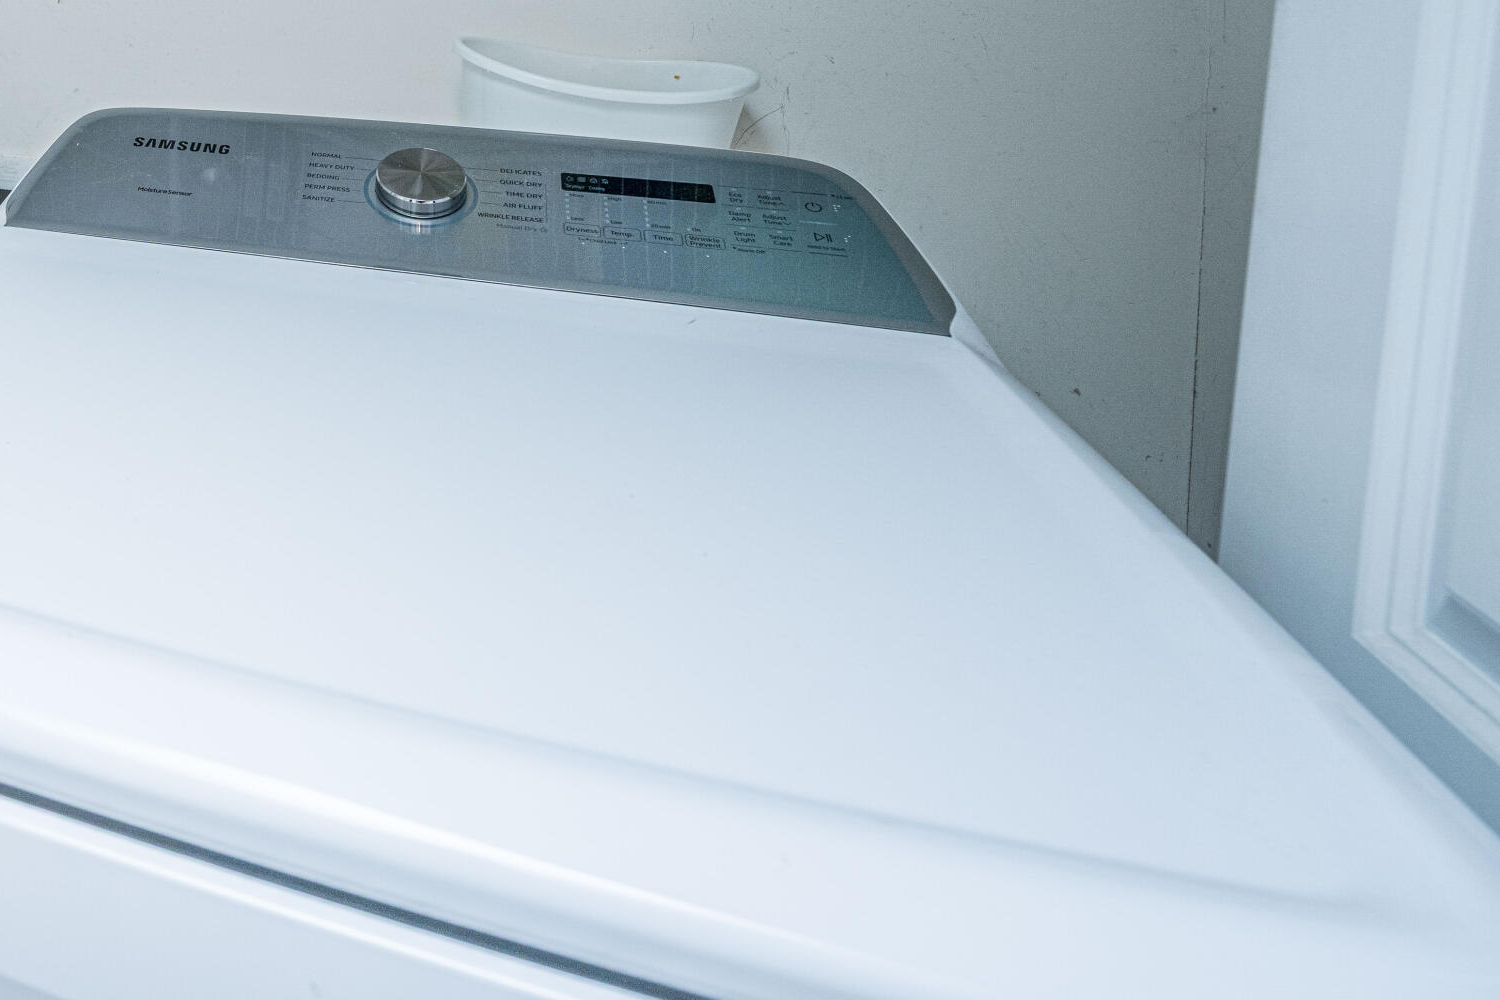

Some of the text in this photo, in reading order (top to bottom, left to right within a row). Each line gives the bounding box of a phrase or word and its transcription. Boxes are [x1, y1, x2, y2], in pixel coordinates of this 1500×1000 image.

[133, 136, 231, 155] SAMSUNG
[311, 151, 342, 159] NORMAL
[500, 168, 543, 176] DELICATES
[307, 172, 340, 181] BEDDING
[138, 186, 193, 197] Moisture Sensor
[327, 185, 351, 193] PRESS
[505, 190, 525, 198] TIME
[757, 194, 782, 202] Adjust
[302, 194, 336, 203] SANITIZE
[477, 212, 543, 223] WRINKLE RELEASE
[728, 210, 751, 218] Damp
[762, 213, 787, 221] Adjust
[566, 226, 600, 235] Dryness
[610, 230, 635, 239] Temp.
[733, 230, 756, 238] Drum
[653, 234, 674, 242] Time
[688, 235, 721, 244] Wrinkle
[735, 236, 756, 244] Light
[689, 241, 722, 249] Prevent
